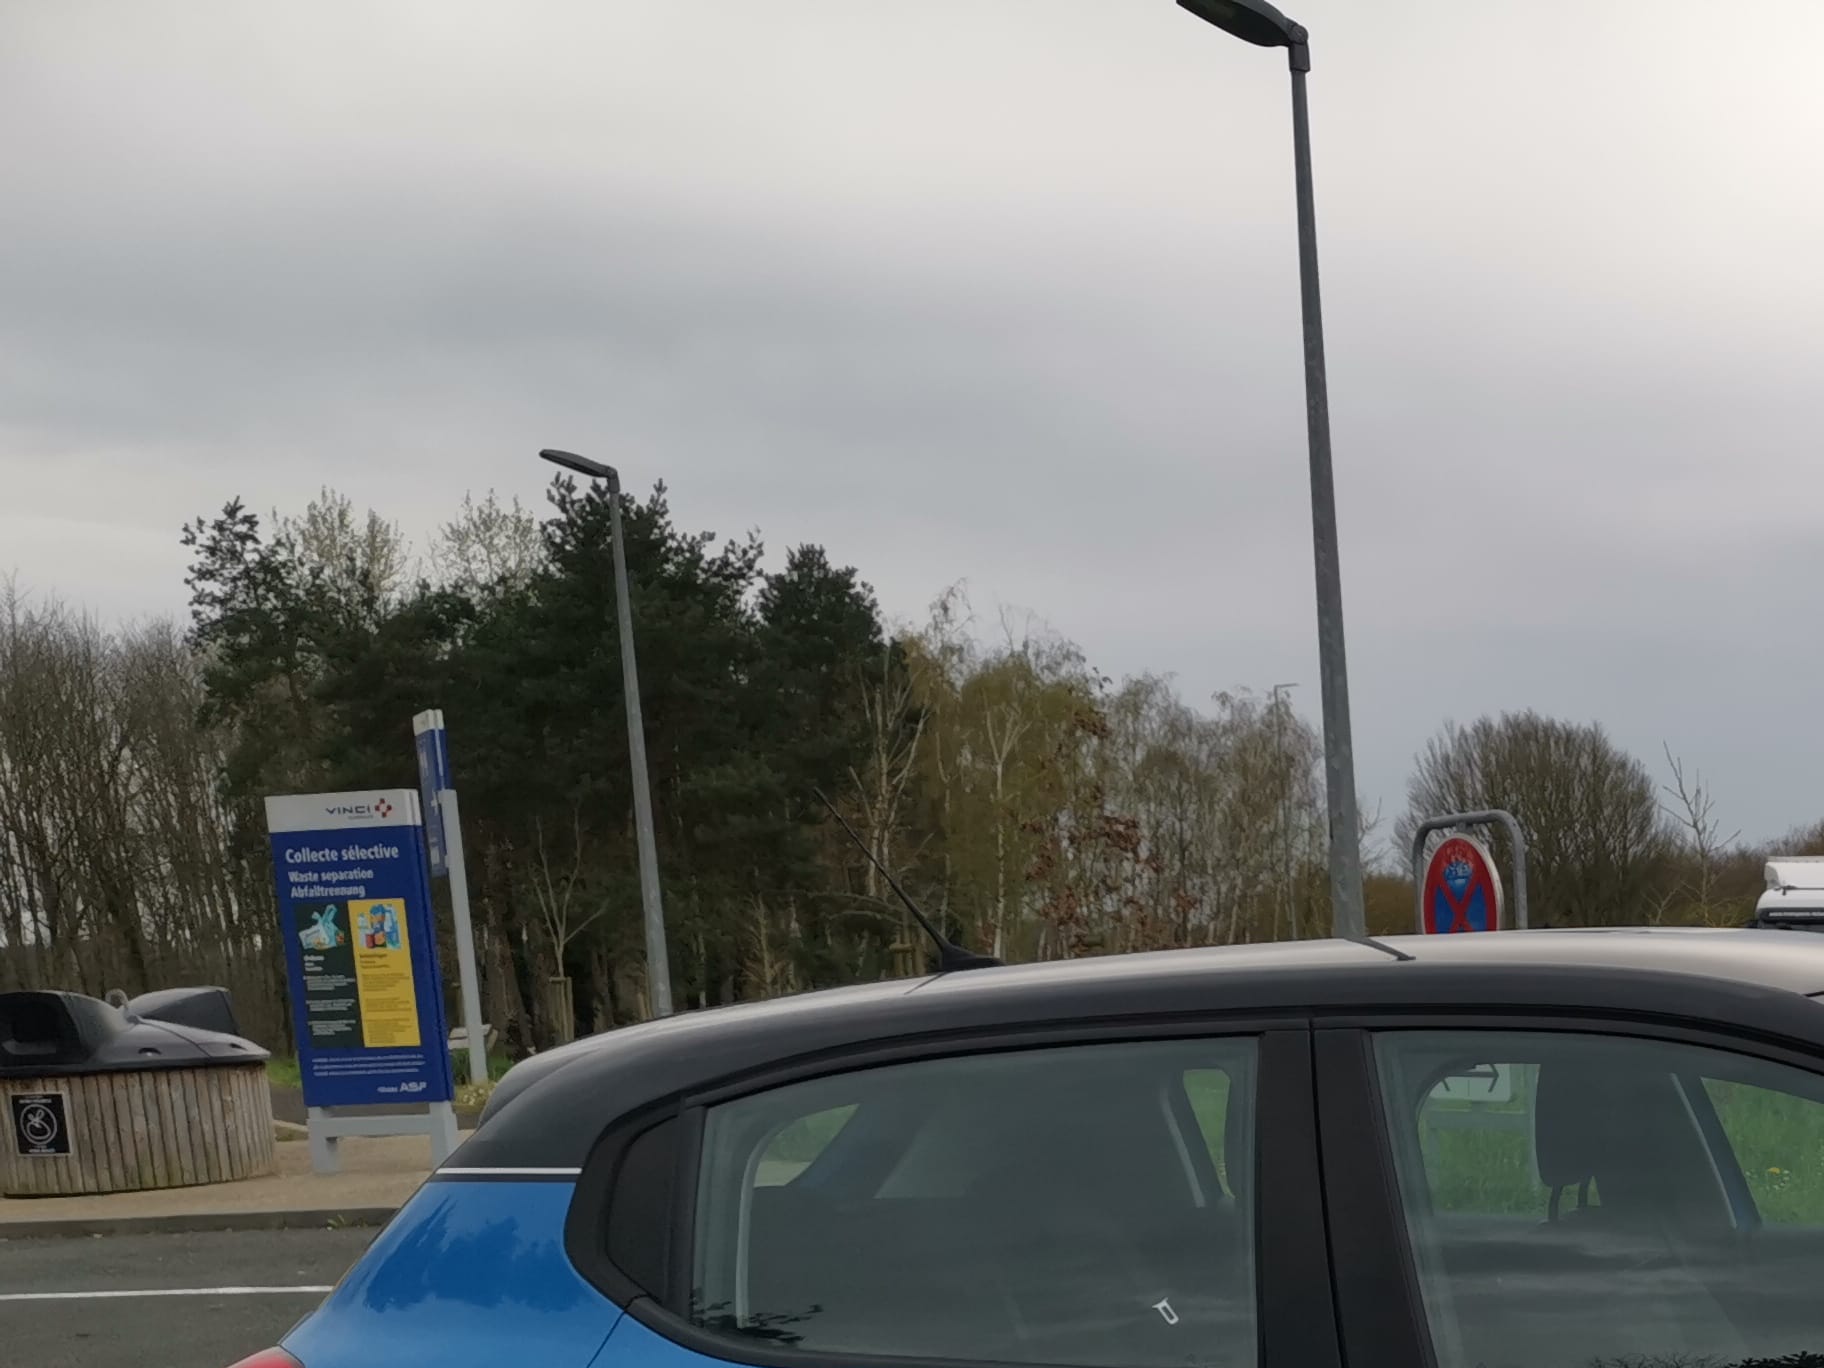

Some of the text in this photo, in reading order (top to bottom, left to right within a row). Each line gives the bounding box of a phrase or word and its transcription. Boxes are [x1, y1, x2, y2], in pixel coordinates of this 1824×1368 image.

[325, 804, 371, 815] VINCI
[285, 843, 399, 864] Collecte sélective
[287, 867, 374, 884] Waste separation
[290, 885, 366, 899] Abfalltrennung
